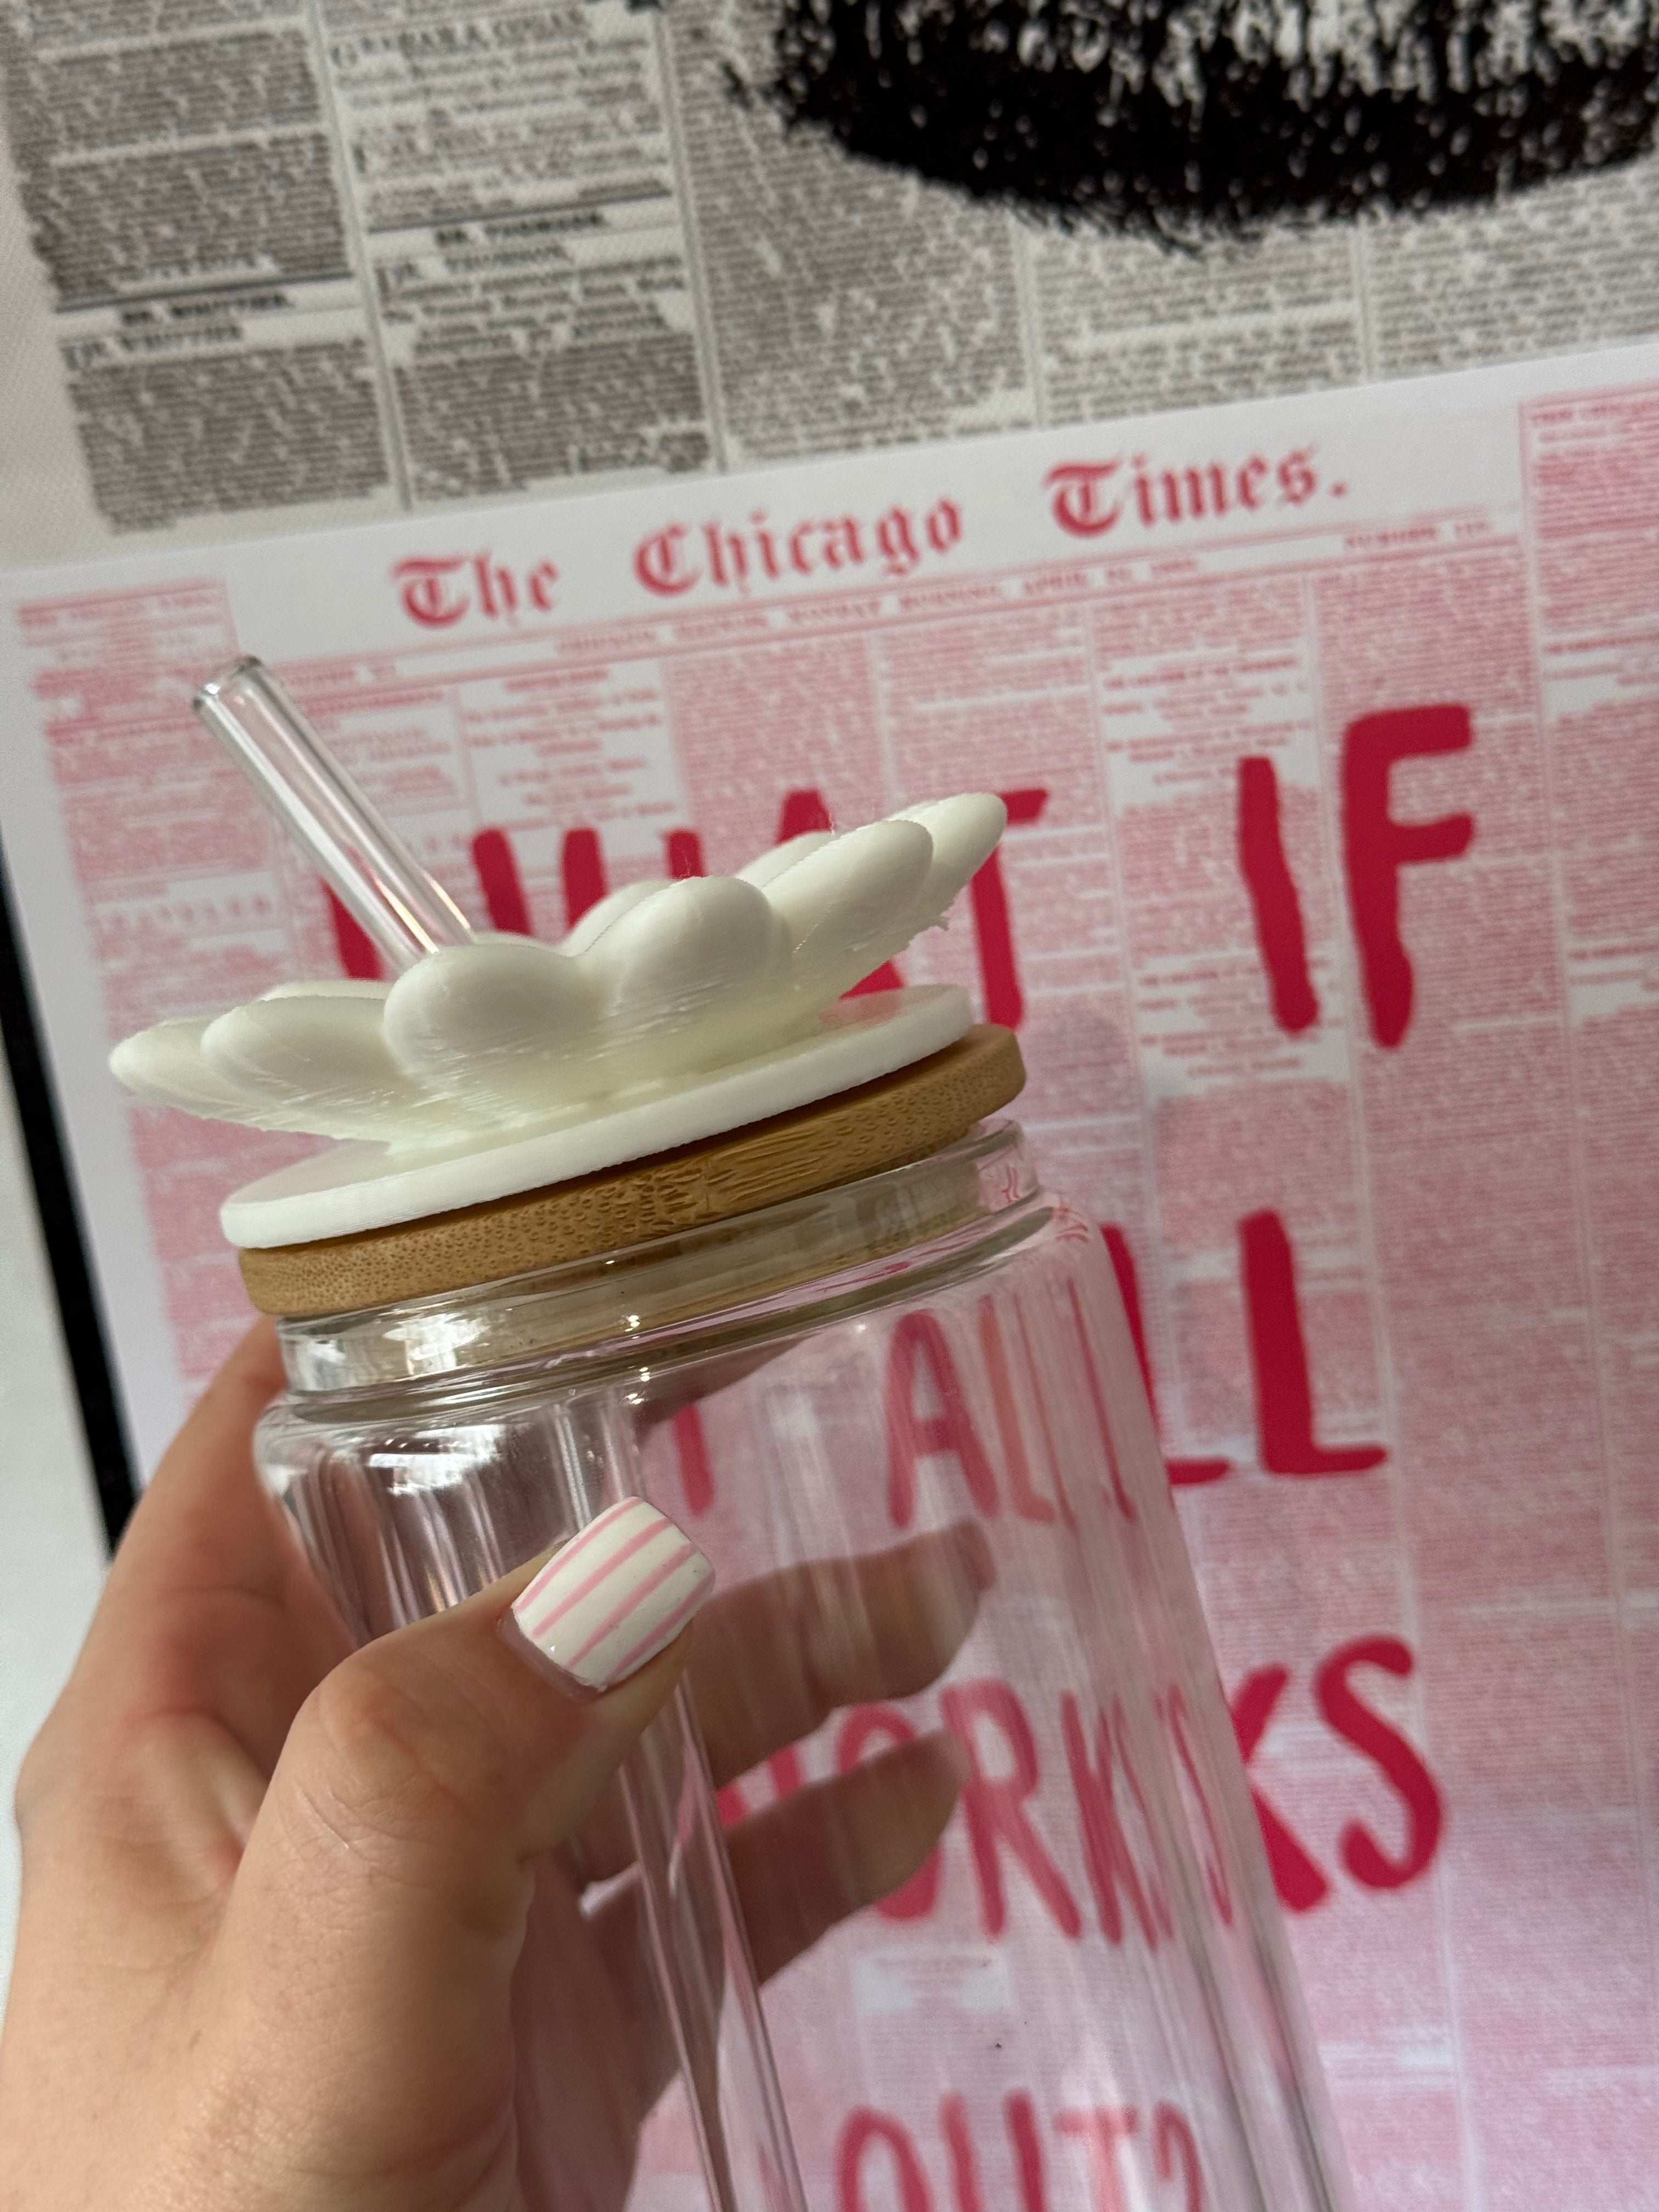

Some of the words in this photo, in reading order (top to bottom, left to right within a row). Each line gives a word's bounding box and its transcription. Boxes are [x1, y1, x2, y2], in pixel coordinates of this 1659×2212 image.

[392, 554, 558, 629] The
[633, 498, 964, 597] Chicago
[1043, 443, 1348, 538] Times.
[1238, 703, 1476, 1048] IF
